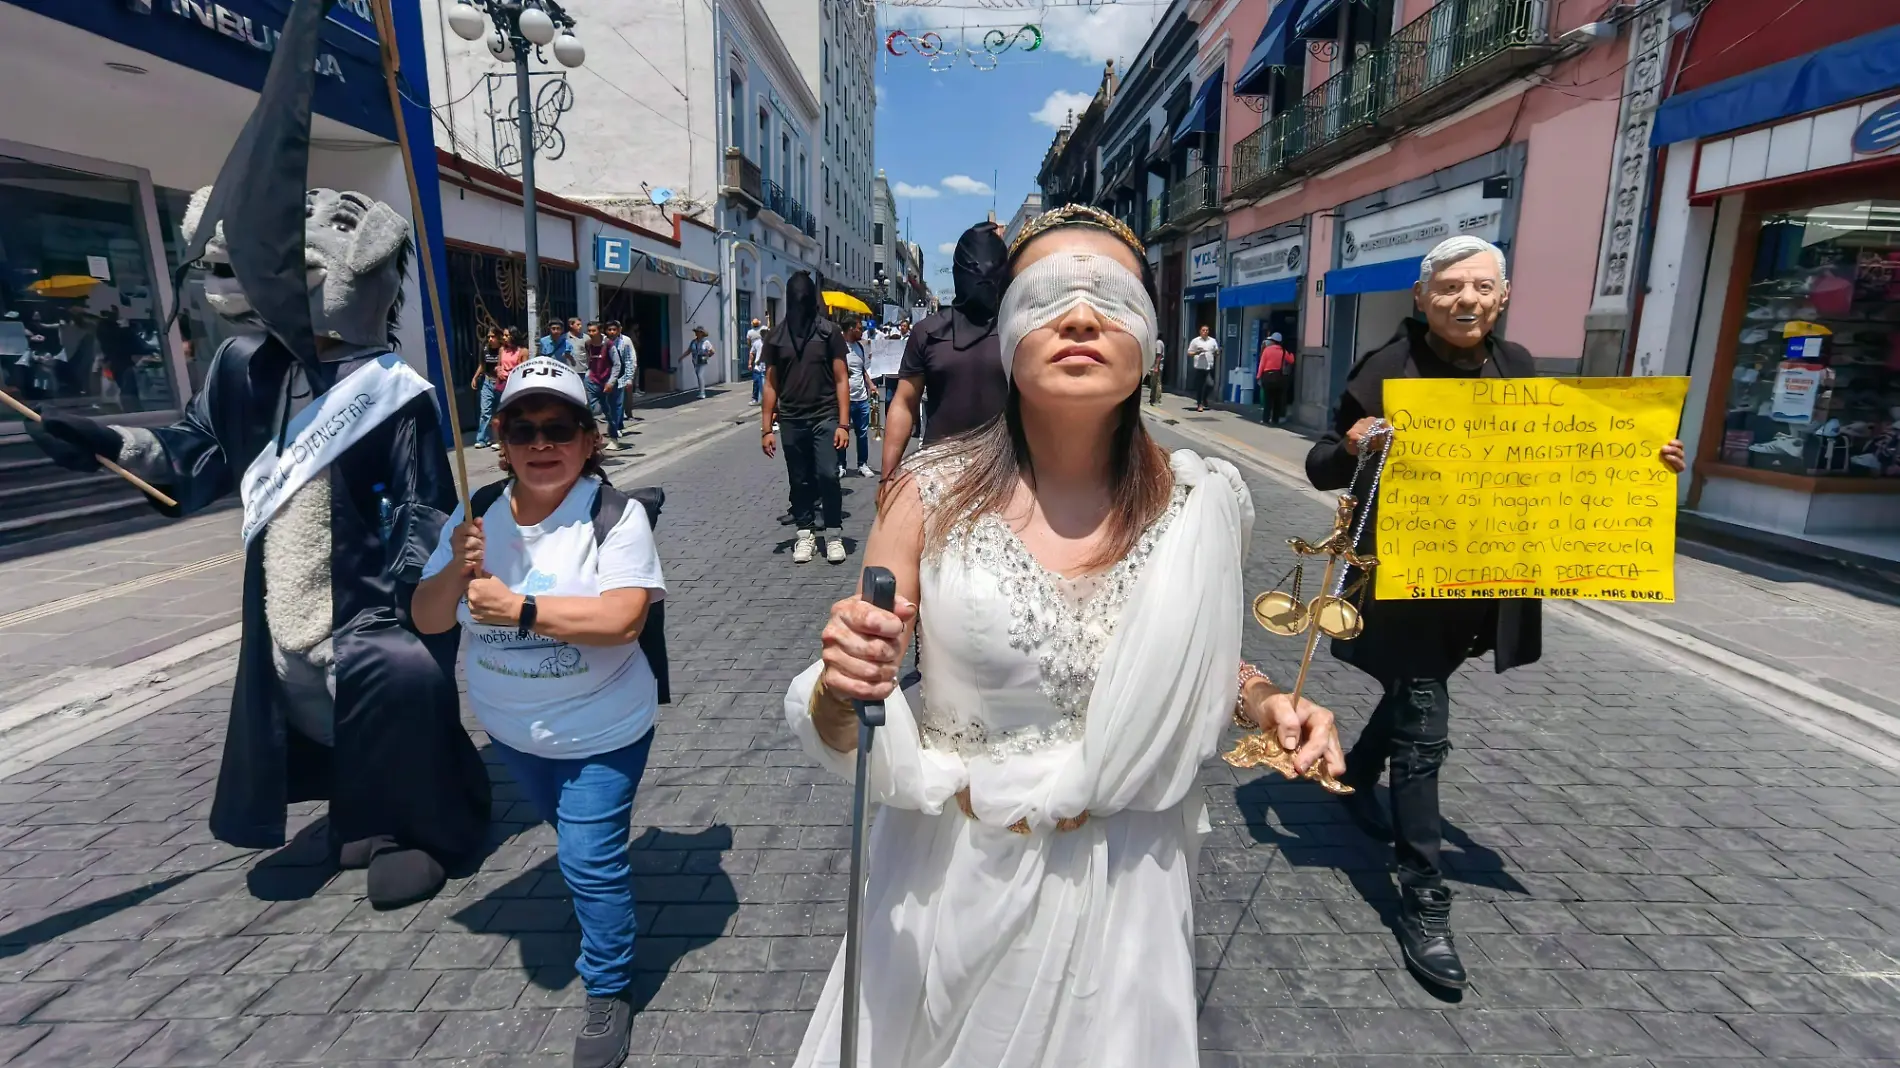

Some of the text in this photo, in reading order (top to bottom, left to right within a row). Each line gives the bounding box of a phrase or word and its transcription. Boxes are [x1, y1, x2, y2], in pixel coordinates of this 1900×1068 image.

[605, 240, 622, 269] E
[521, 367, 563, 379] PJF
[288, 393, 377, 465] BIENESTAR
[1391, 409, 1635, 439] Quiero quitar a todos los
[1395, 440, 1472, 459] JUECES
[1506, 440, 1653, 463] MAGISTRADOS
[1390, 461, 1442, 482] Para
[1456, 470, 1538, 489] imponer
[1549, 471, 1561, 484] a
[1570, 465, 1597, 485] los
[1605, 466, 1640, 486] que
[1386, 488, 1431, 515] diga
[1493, 491, 1551, 517] hagan
[1559, 491, 1574, 507] lo
[1580, 494, 1614, 512] que
[1627, 491, 1659, 508] les
[1485, 516, 1538, 533] llevar
[1549, 518, 1560, 530] a
[1569, 513, 1586, 531] la
[1593, 515, 1653, 529] ruina
[1382, 537, 1400, 556] al
[1466, 540, 1515, 555] como
[1522, 541, 1546, 554] en
[1550, 536, 1654, 555] Venezuela
[1433, 562, 1542, 584] DICTADURA
[1471, 588, 1495, 598] MAS
[1498, 588, 1528, 598] PODER
[1533, 588, 1546, 598] AL
